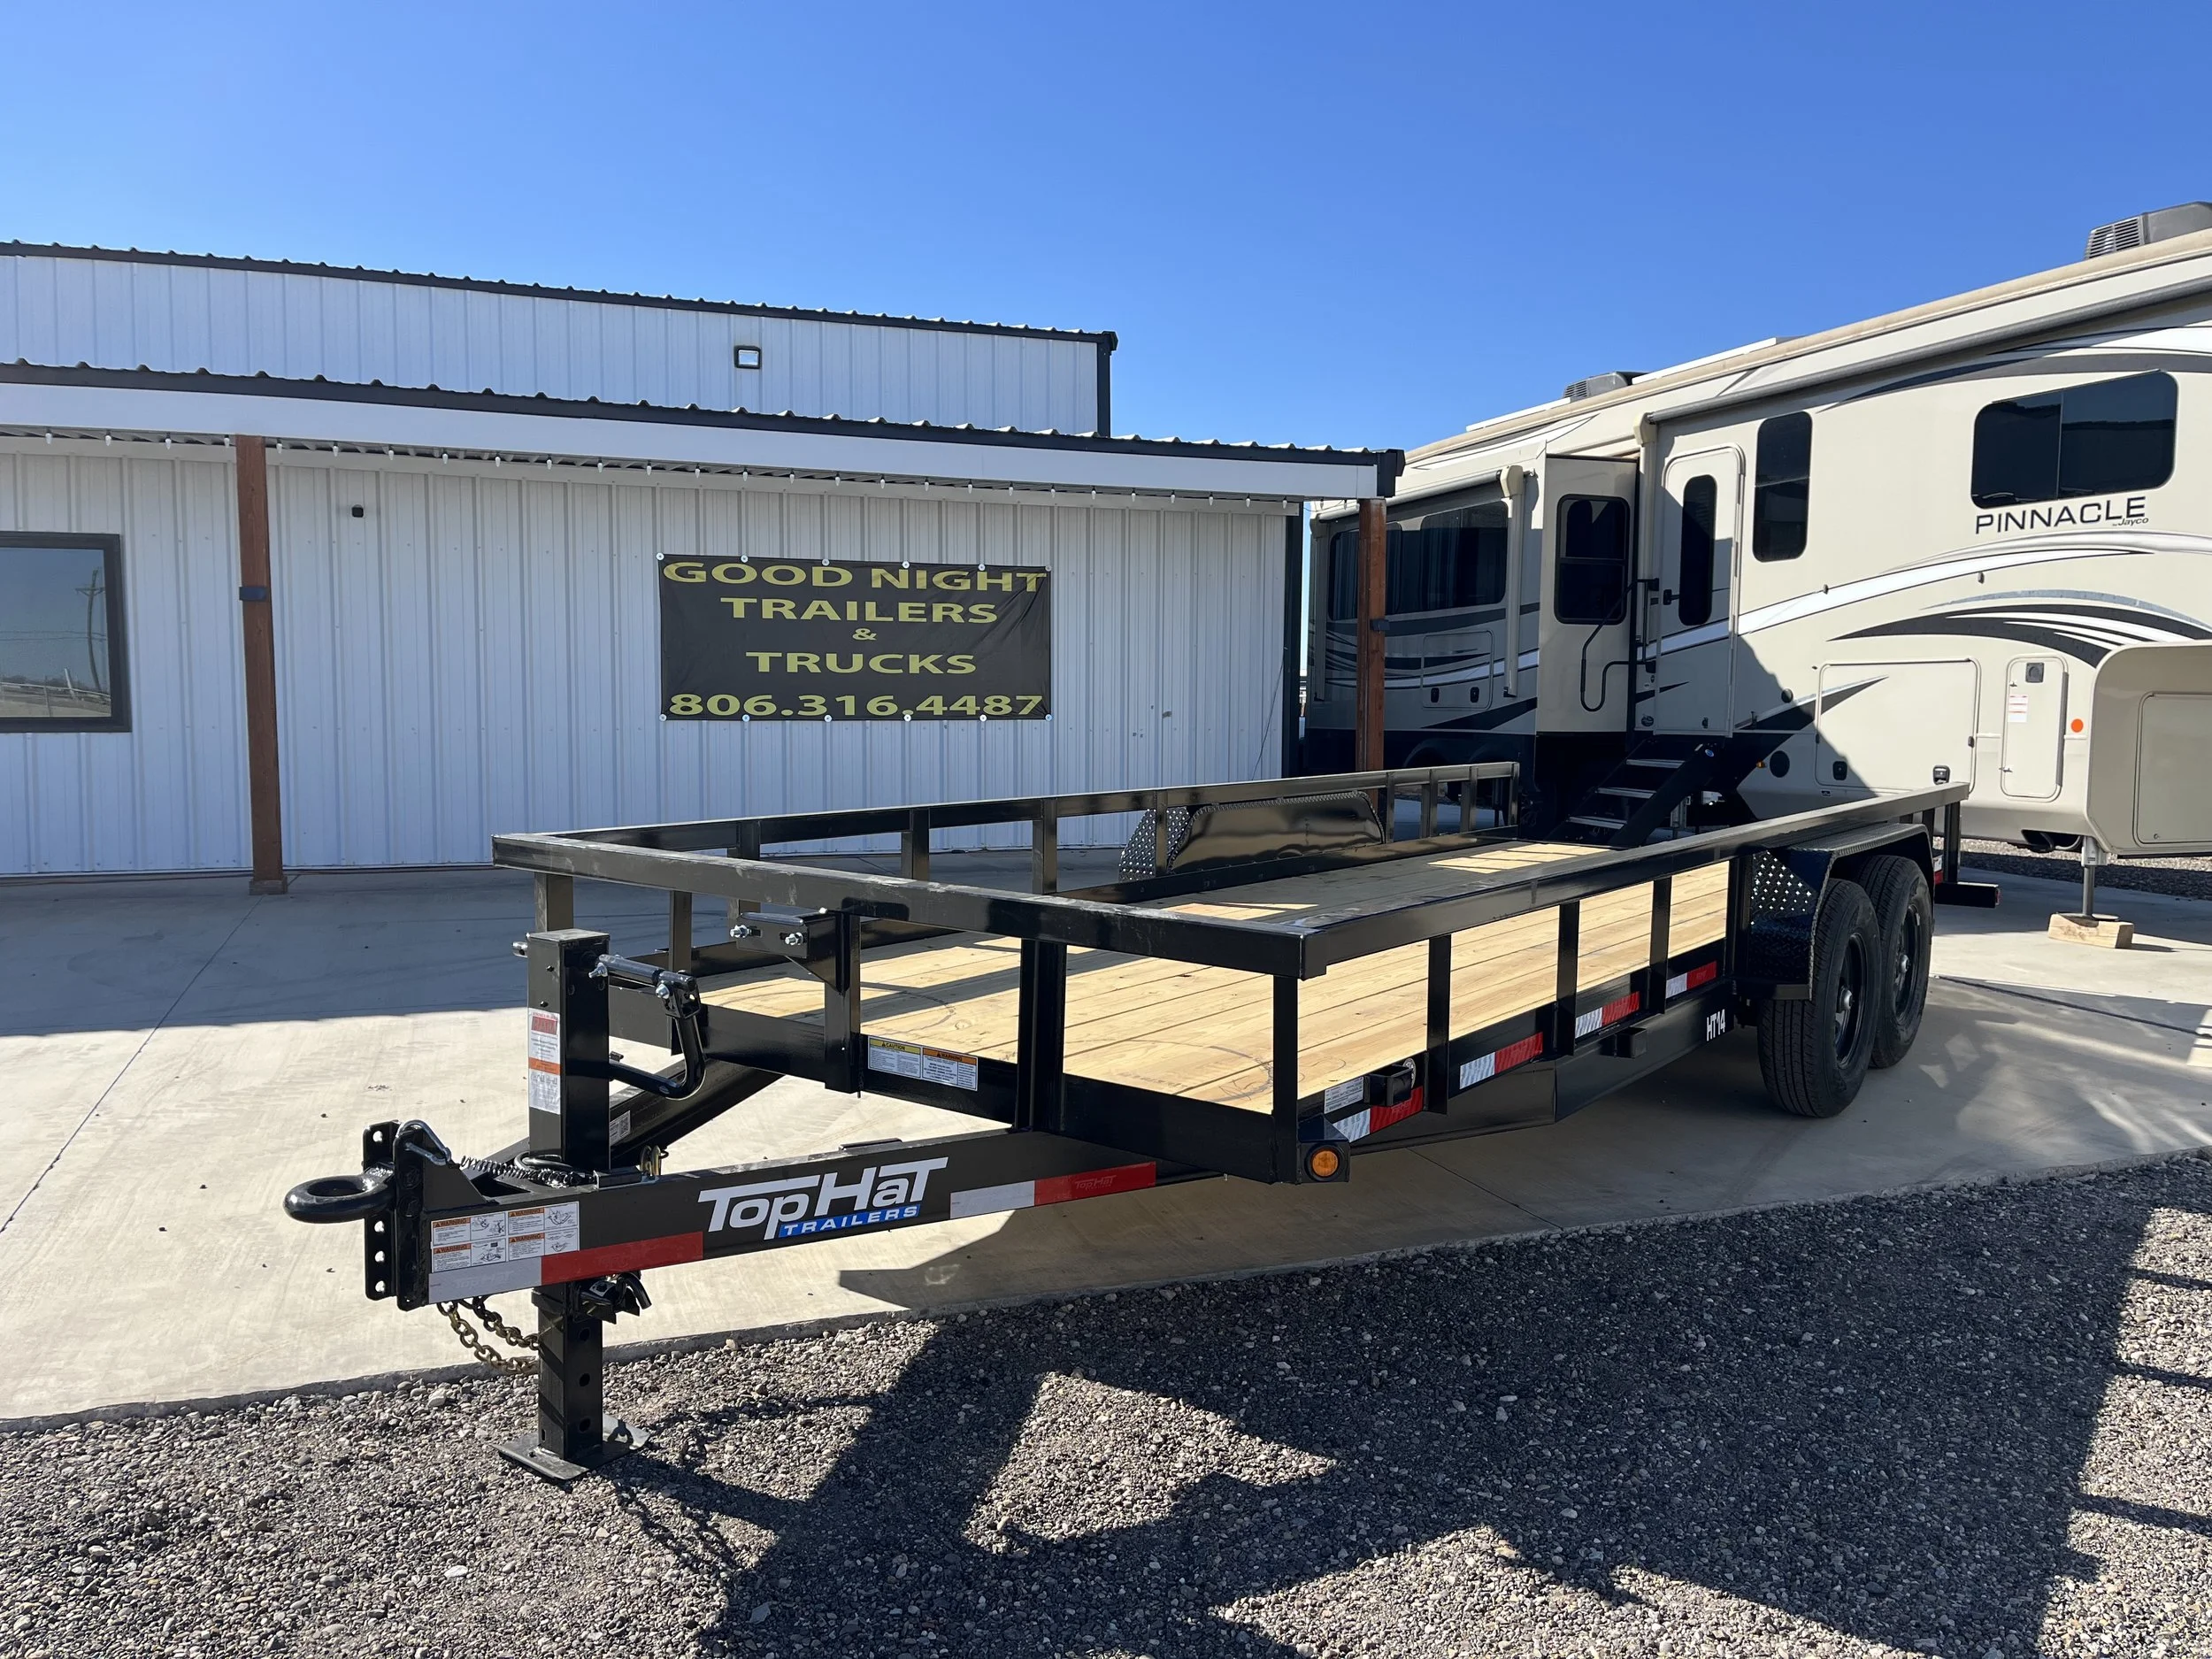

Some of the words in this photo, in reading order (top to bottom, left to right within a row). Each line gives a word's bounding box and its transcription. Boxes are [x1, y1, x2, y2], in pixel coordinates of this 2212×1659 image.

[1975, 495, 2147, 534] PINNACLE
[2117, 517, 2149, 527] Jayco
[663, 562, 853, 588] GOOD
[871, 567, 1048, 592] NIGHT
[720, 597, 998, 623] TRAILERS
[852, 627, 877, 641] &
[745, 651, 977, 674] TRUCKS
[669, 693, 1043, 717] 806.316.4487
[1706, 1009, 1726, 1041] HT14
[441, 1217, 467, 1227] WARNING
[782, 1206, 918, 1236] TRAILERS
[442, 1243, 468, 1253] WARNING
[516, 1233, 542, 1241] WARNING
